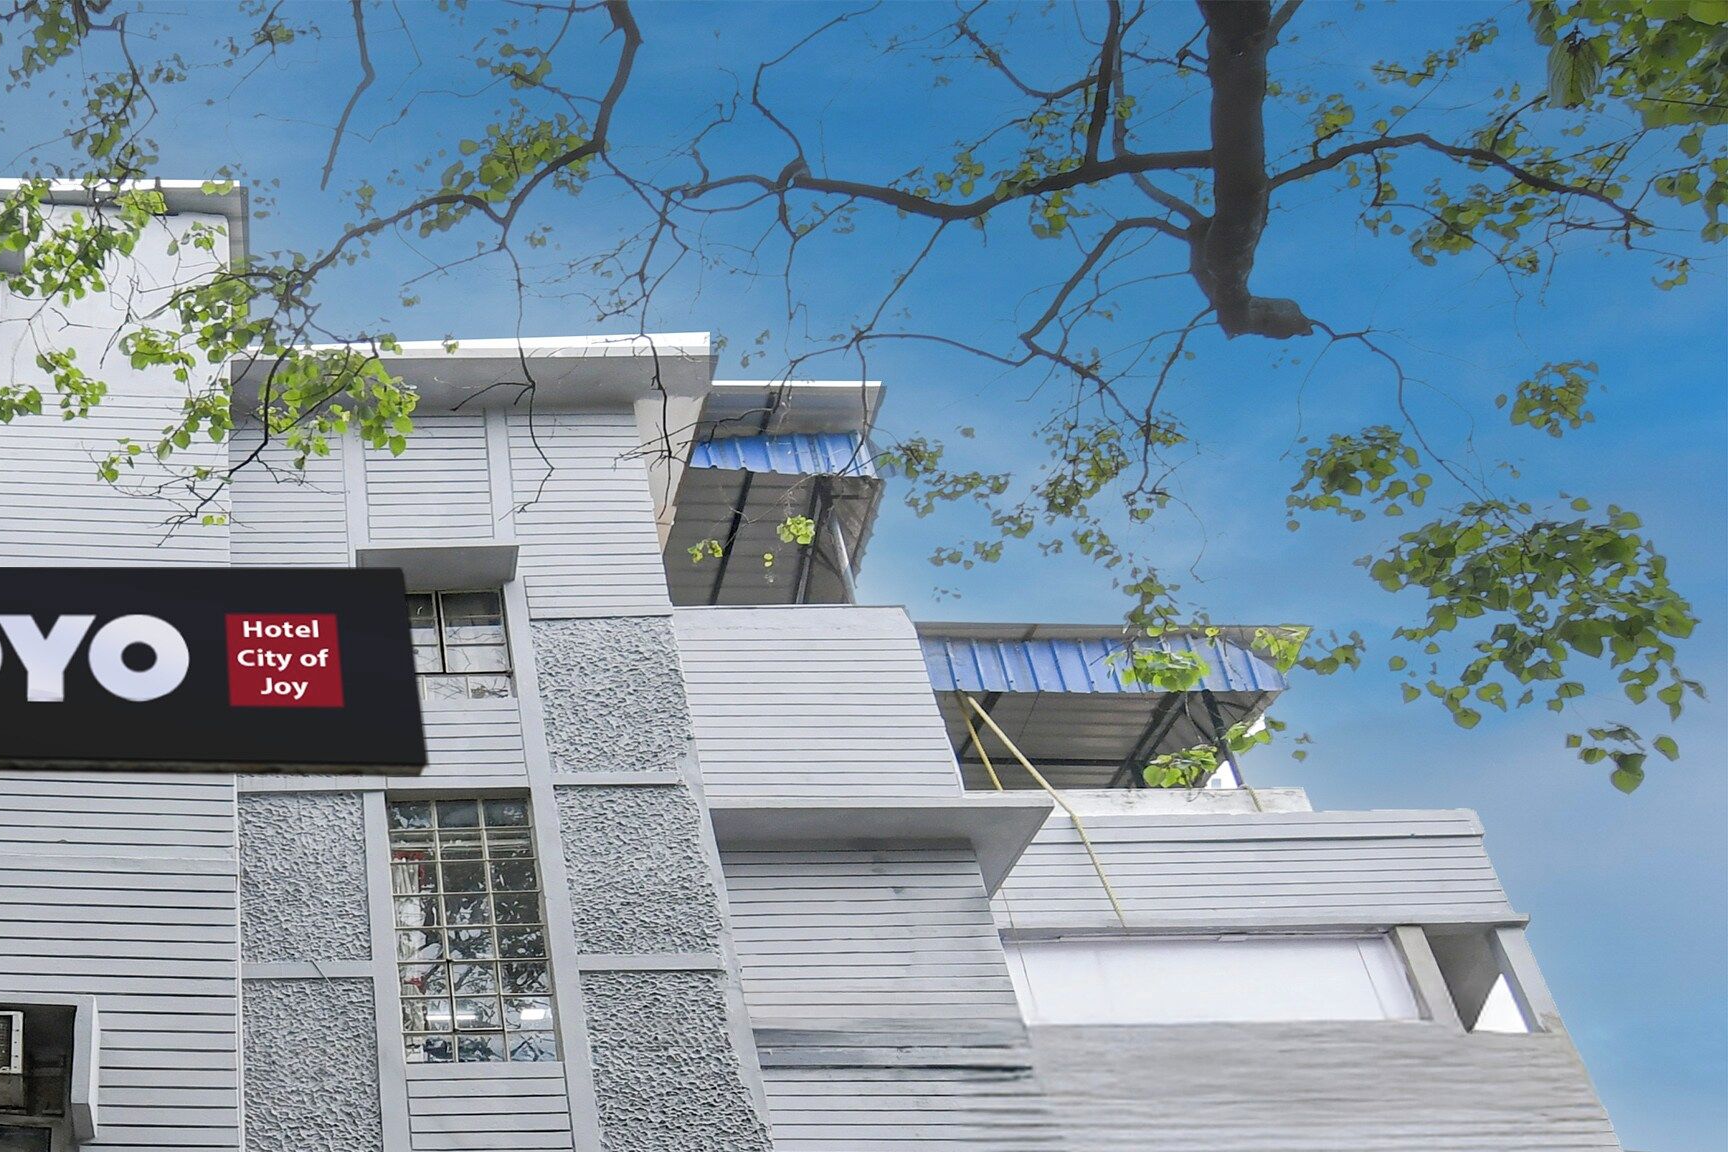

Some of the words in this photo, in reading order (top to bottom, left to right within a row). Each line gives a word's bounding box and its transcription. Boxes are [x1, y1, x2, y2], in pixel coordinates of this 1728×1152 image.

[243, 620, 319, 637] Hotel
[237, 649, 292, 671] City
[300, 649, 328, 667] of
[261, 678, 308, 699] Joy
